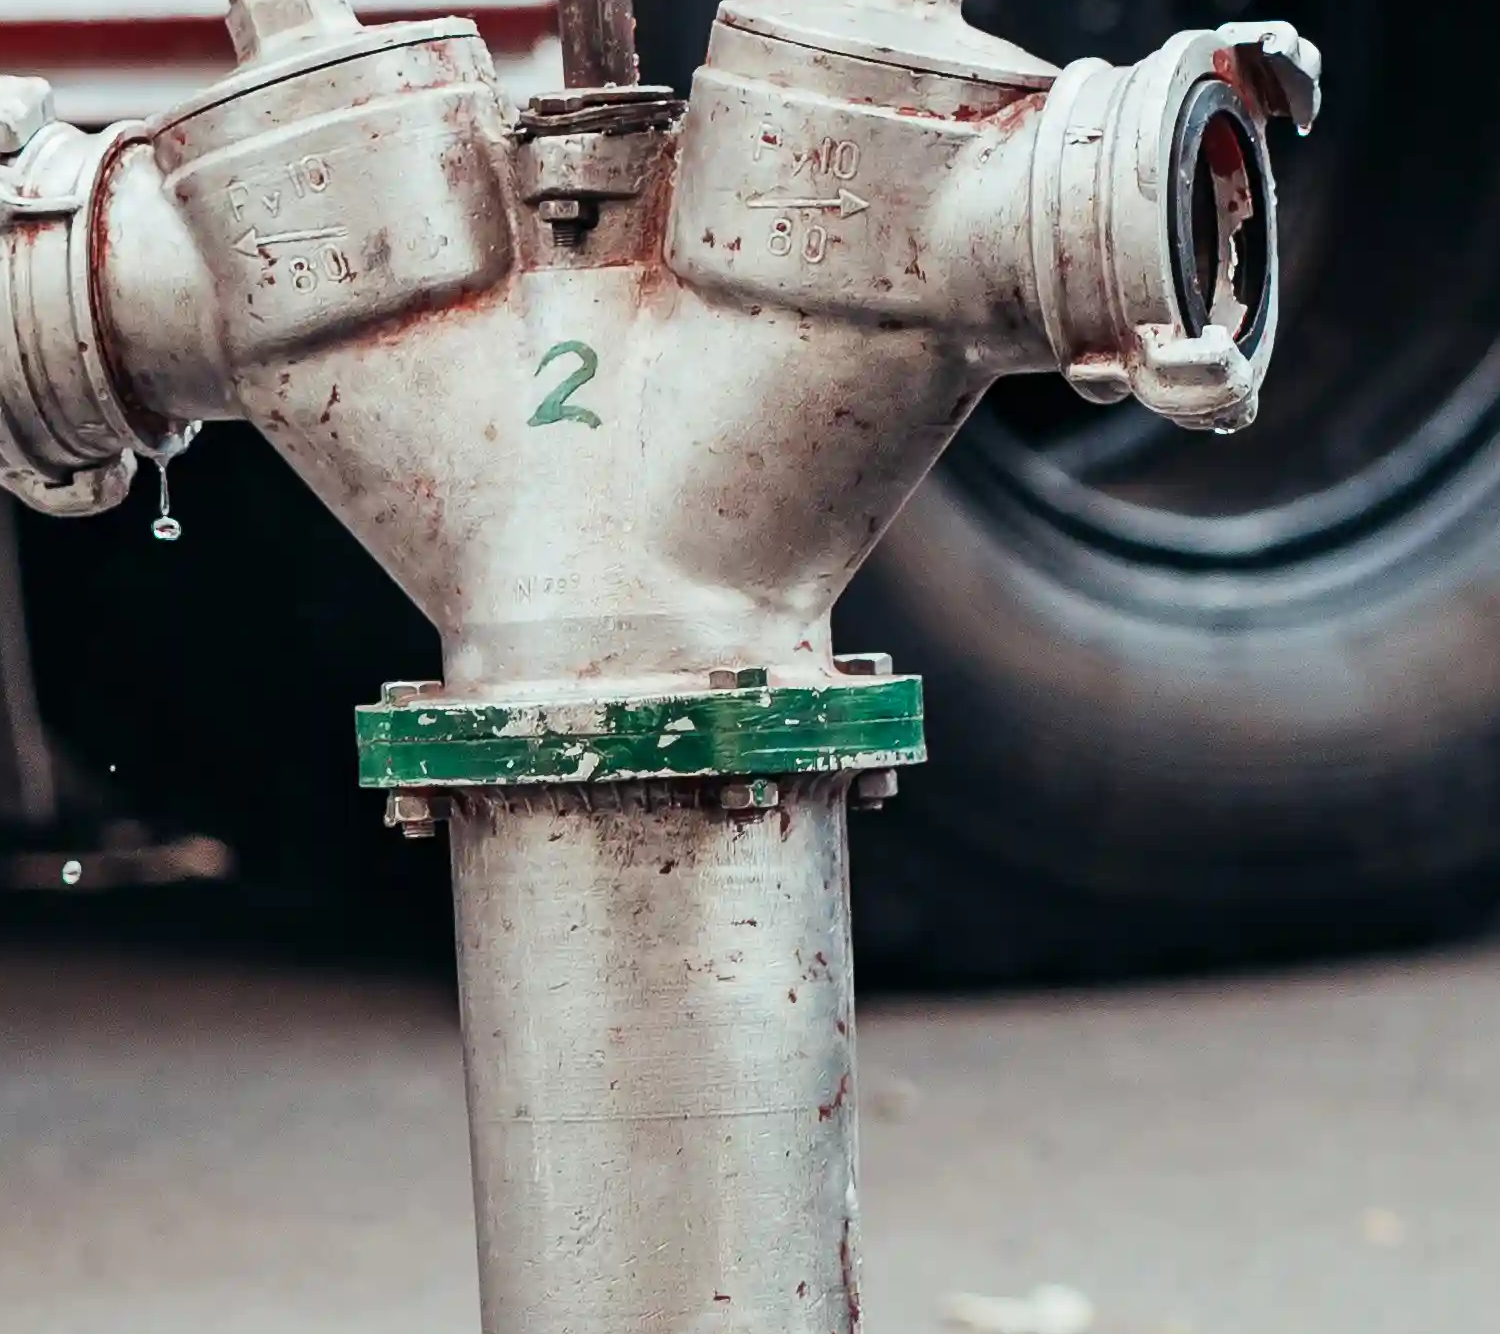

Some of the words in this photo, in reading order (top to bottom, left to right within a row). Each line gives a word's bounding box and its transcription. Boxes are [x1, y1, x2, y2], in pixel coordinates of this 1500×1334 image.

[768, 217, 828, 264] 80
[289, 242, 350, 294] 80
[526, 340, 602, 429] 2
